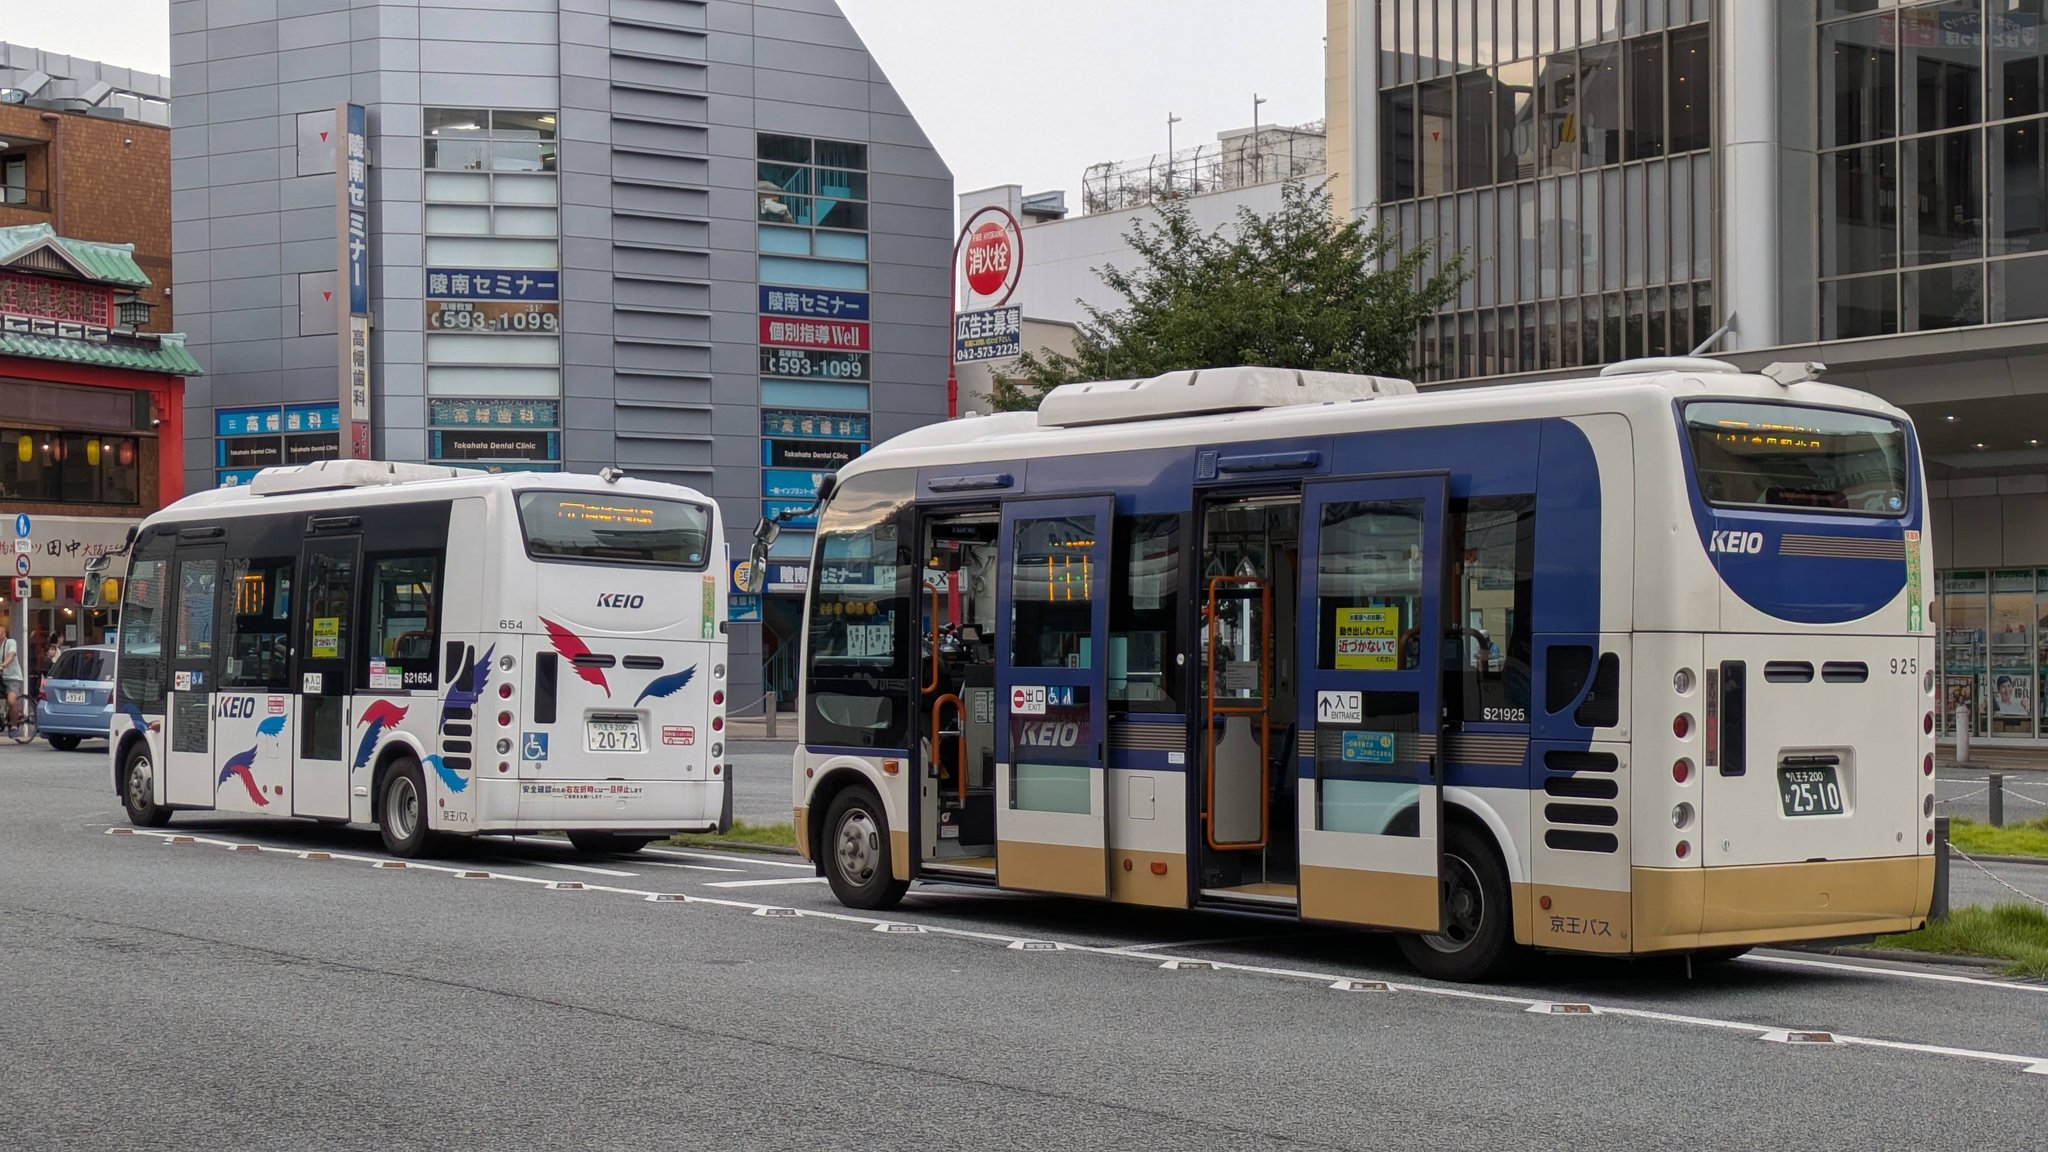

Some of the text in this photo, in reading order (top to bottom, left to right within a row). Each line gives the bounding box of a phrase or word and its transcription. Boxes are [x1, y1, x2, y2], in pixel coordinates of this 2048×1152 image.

[347, 134, 365, 286] 陵南セミナー
[969, 241, 1008, 276] 消火栓
[429, 273, 555, 295] 陵南セミナー
[768, 291, 859, 314] 陵南セミナー
[443, 311, 555, 330] 593-1099
[957, 309, 1019, 340] 広告主募集
[769, 322, 860, 346] 個別指導 Well
[957, 343, 1019, 361] 042-573-2225
[778, 358, 862, 378] 593-1099
[490, 442, 514, 450] Dental
[516, 442, 536, 450] Clinic
[812, 451, 832, 459] Dental
[832, 452, 848, 460] Clinic
[46, 539, 82, 559] 田中
[1709, 530, 1763, 554] KEIO
[597, 592, 644, 609] KEIO
[500, 620, 523, 630] 654
[1339, 626, 1393, 636] 動き出したバスには
[1338, 639, 1395, 653] 近づかないで
[1890, 658, 1917, 675] 925
[403, 671, 432, 684] S21654
[1026, 688, 1044, 702] 出口
[1335, 695, 1358, 710] 入口
[217, 696, 256, 718] KEIO
[1331, 711, 1360, 720] ENTRANCE
[1483, 707, 1525, 722] S21925
[1020, 721, 1078, 747] KEIO
[443, 810, 468, 822] 京王バス
[1550, 915, 1612, 937] 京王バス
